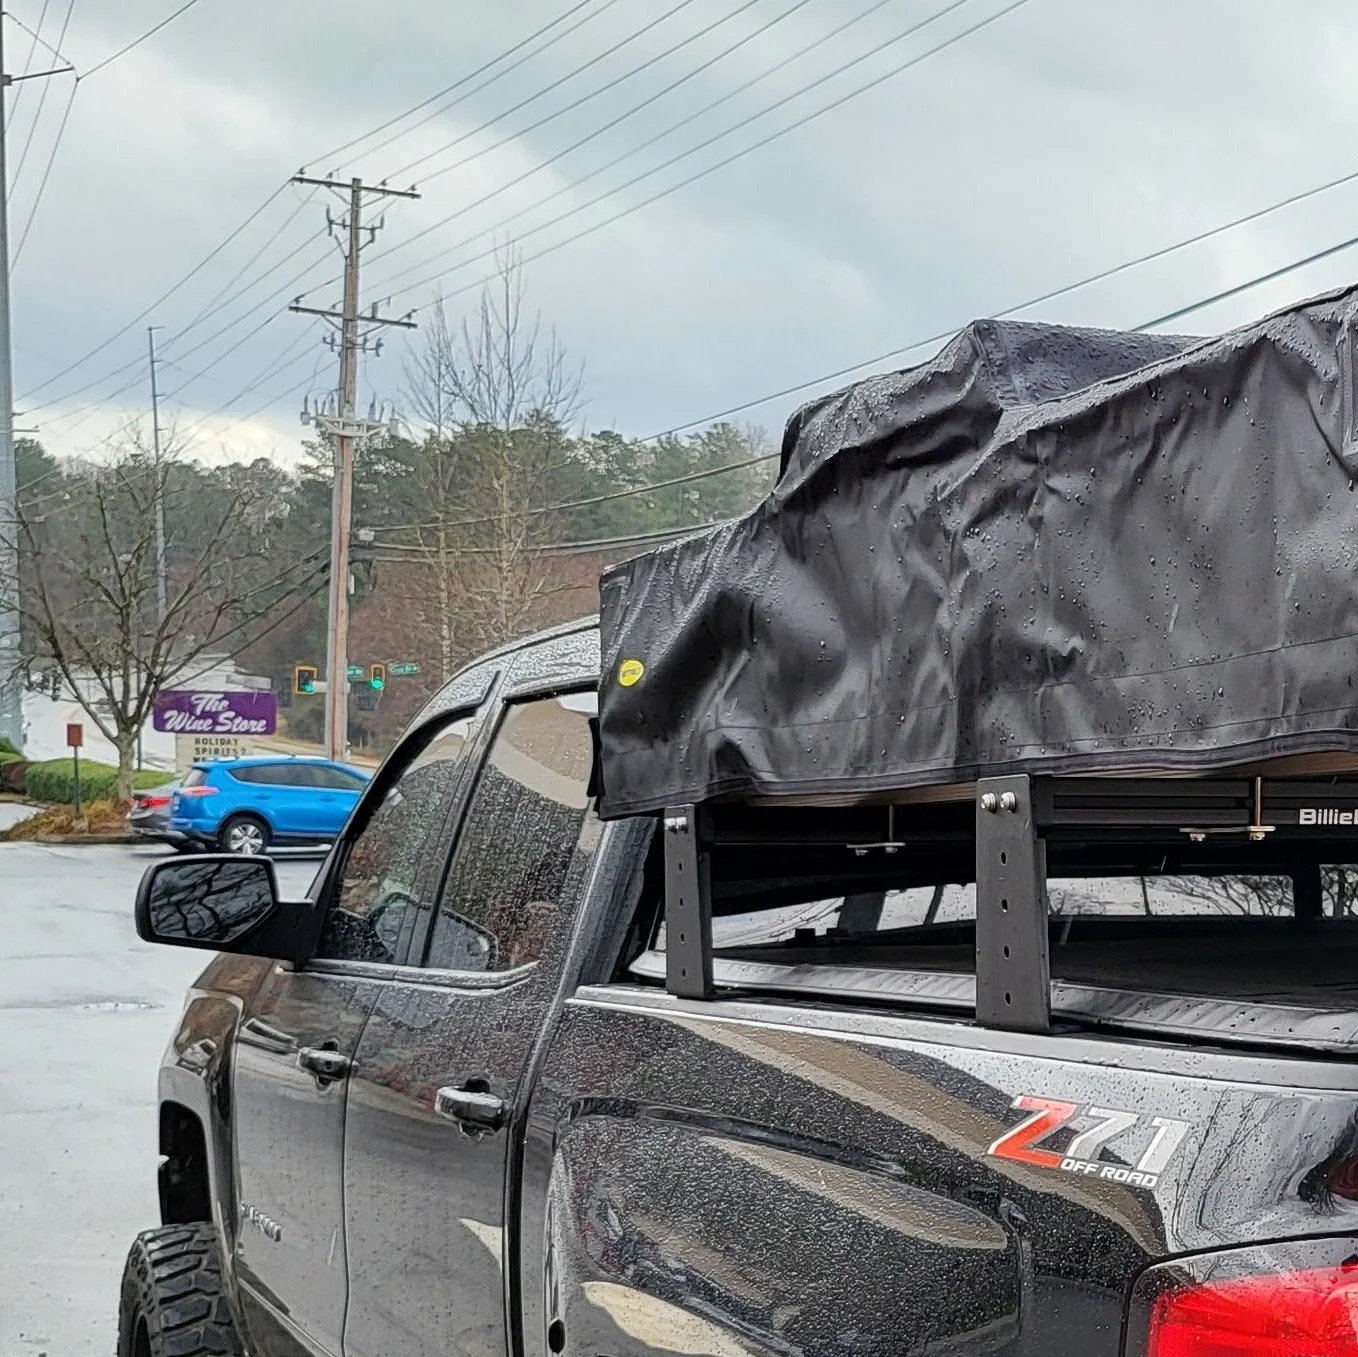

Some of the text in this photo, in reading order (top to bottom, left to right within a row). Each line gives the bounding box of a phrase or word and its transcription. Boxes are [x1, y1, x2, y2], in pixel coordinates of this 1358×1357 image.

[191, 693, 230, 716] The
[163, 709, 268, 733] Wine Store
[194, 737, 239, 746] HOLIDAY
[987, 1095, 1191, 1175] Z71
[1060, 1157, 1159, 1188] OFF ROAD
